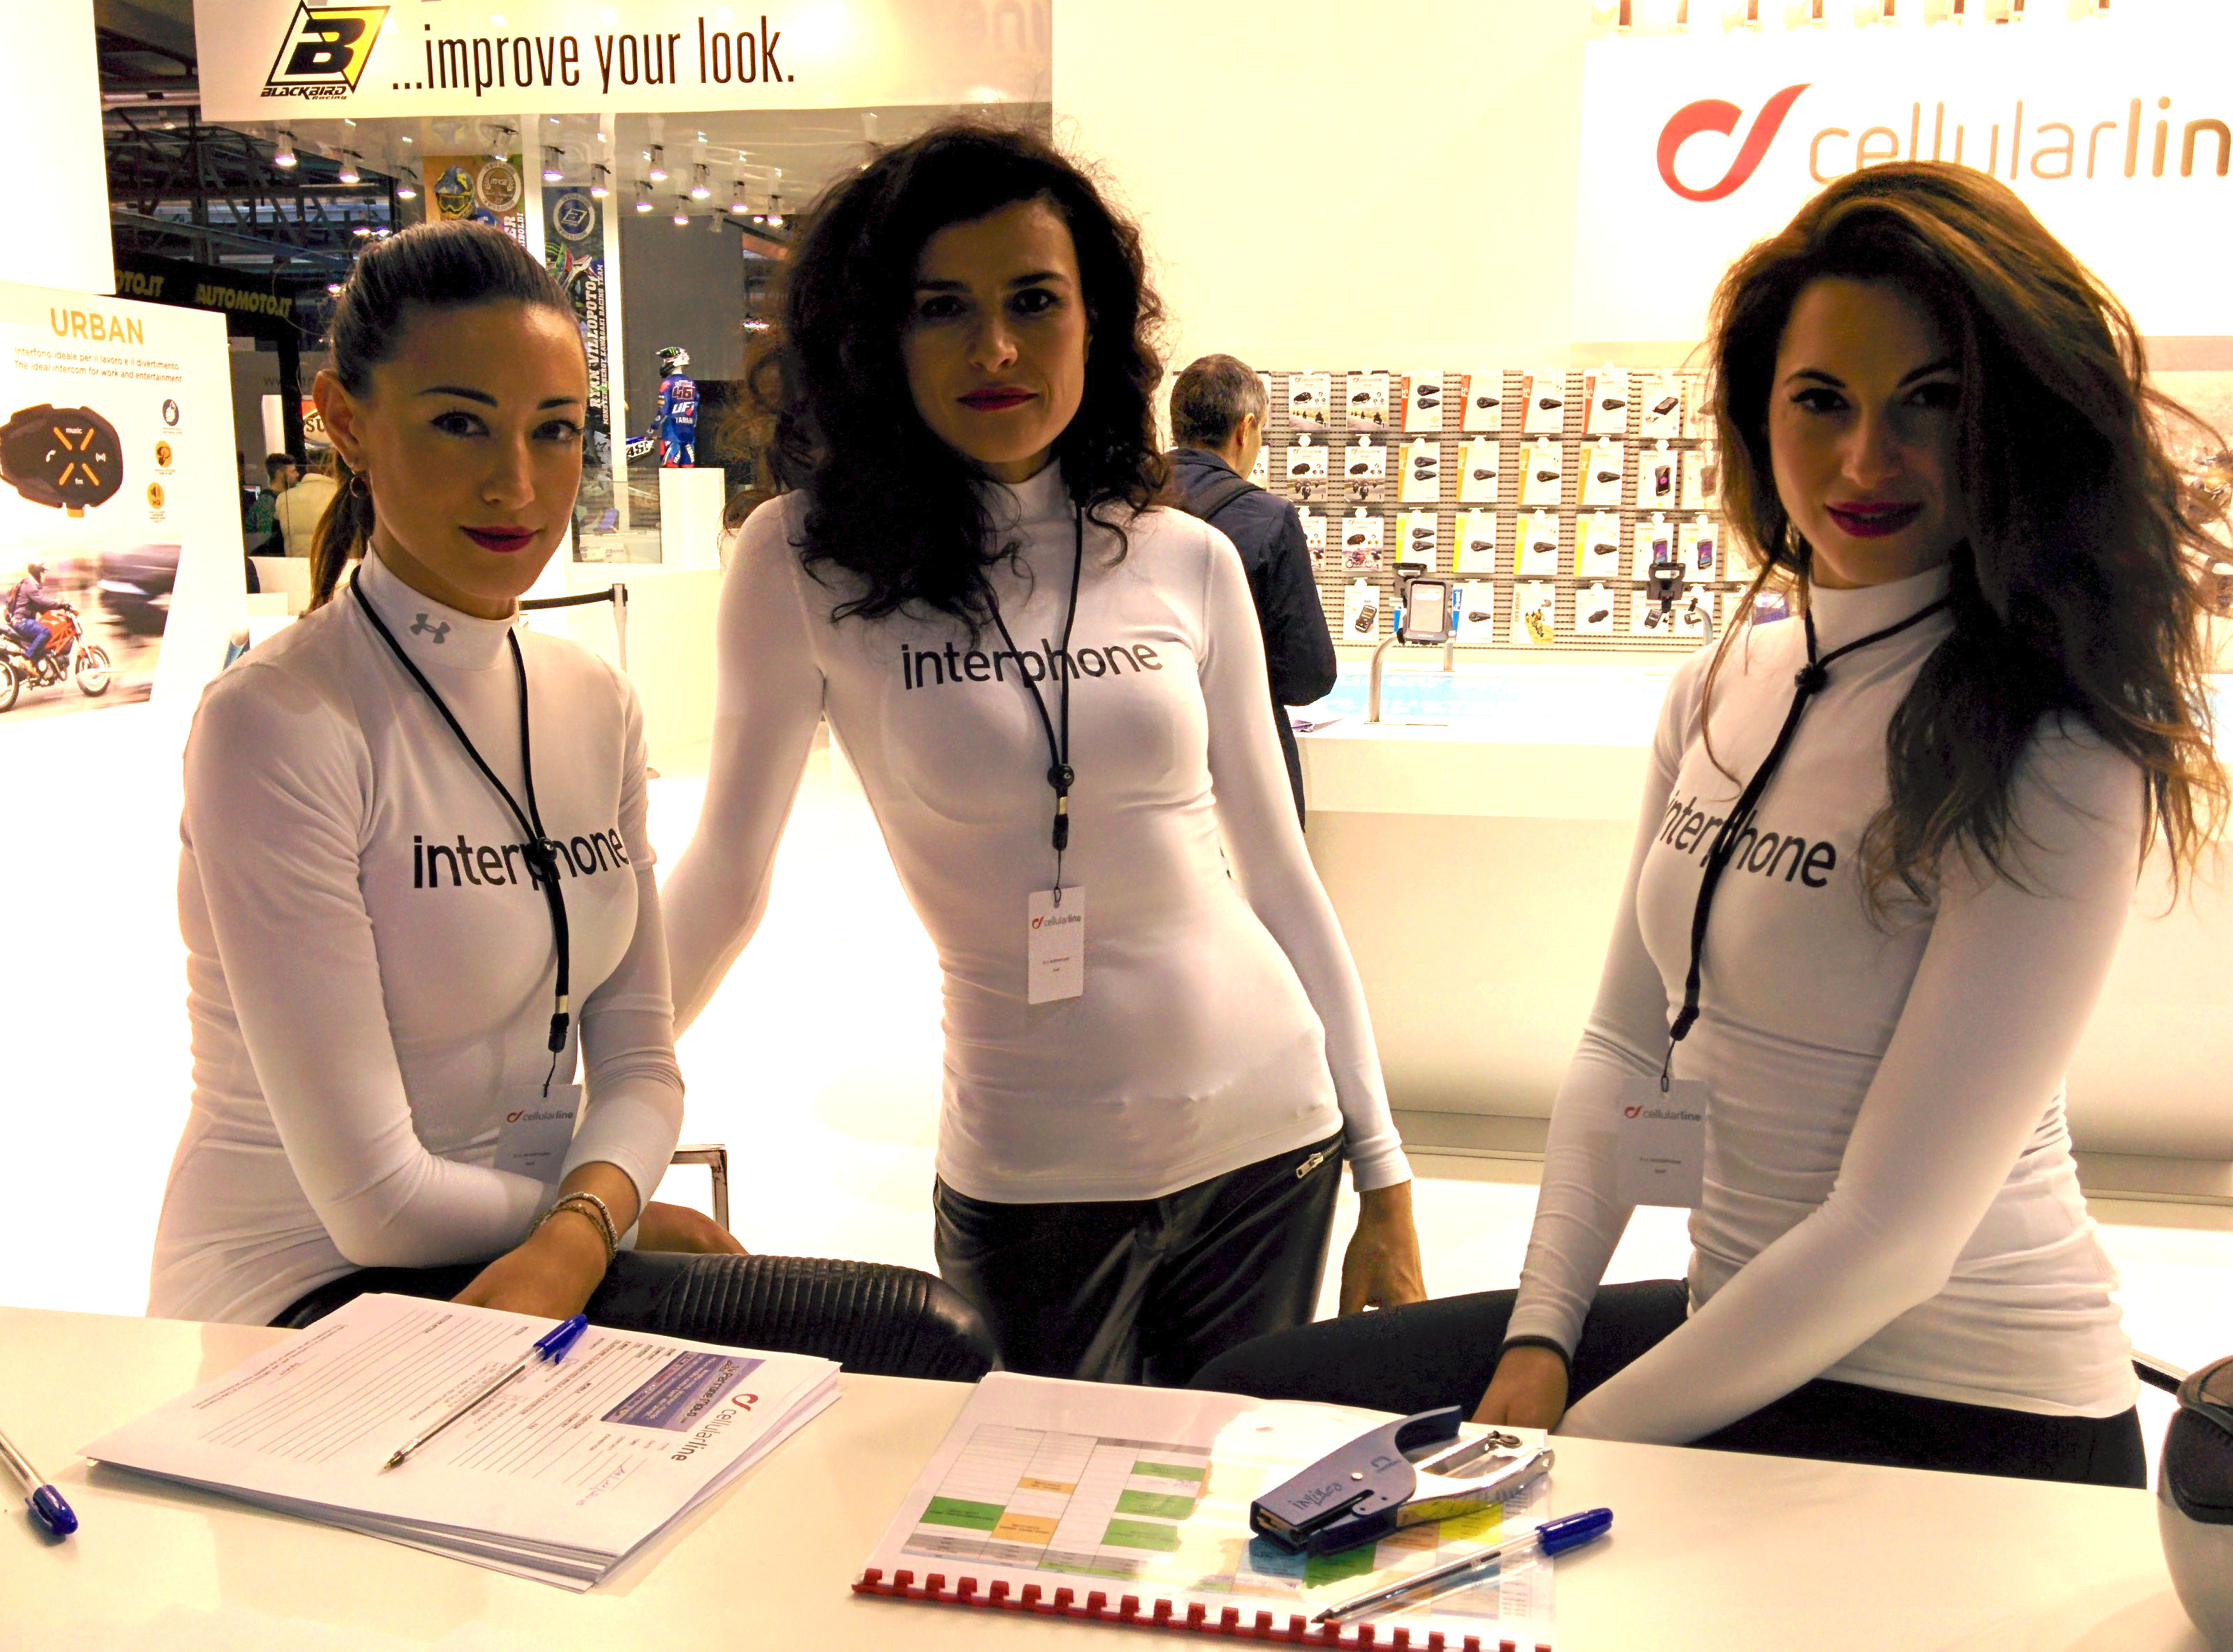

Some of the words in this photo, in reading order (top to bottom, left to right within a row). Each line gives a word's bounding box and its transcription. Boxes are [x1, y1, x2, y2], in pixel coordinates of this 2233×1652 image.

[595, 33, 681, 95] your
[698, 16, 795, 84] look.
[260, 86, 347, 99] BLACKBIRD
[1809, 96, 2233, 186] cellularlin
[195, 283, 292, 317] AUTOMOTO.IT
[50, 308, 144, 345] URBAN
[585, 280, 599, 366] VILLOPOTO
[14, 360, 29, 370] The
[31, 361, 50, 371] ideal
[53, 363, 87, 375] intercom
[89, 366, 99, 375] for
[101, 368, 119, 377] work
[135, 372, 182, 383] entertainment
[15, 346, 52, 359] Interfono
[54, 350, 77, 361] ideale
[80, 354, 92, 363] per
[100, 354, 123, 365] lavoro
[137, 359, 179, 370] divertimento
[589, 369, 602, 409] RYAN
[901, 638, 1163, 689] interphone
[1043, 914, 1082, 927] cellularline
[522, 1110, 574, 1121] cellularline
[1643, 1109, 1702, 1122] cellularline
[671, 1409, 738, 1462] cellularline
